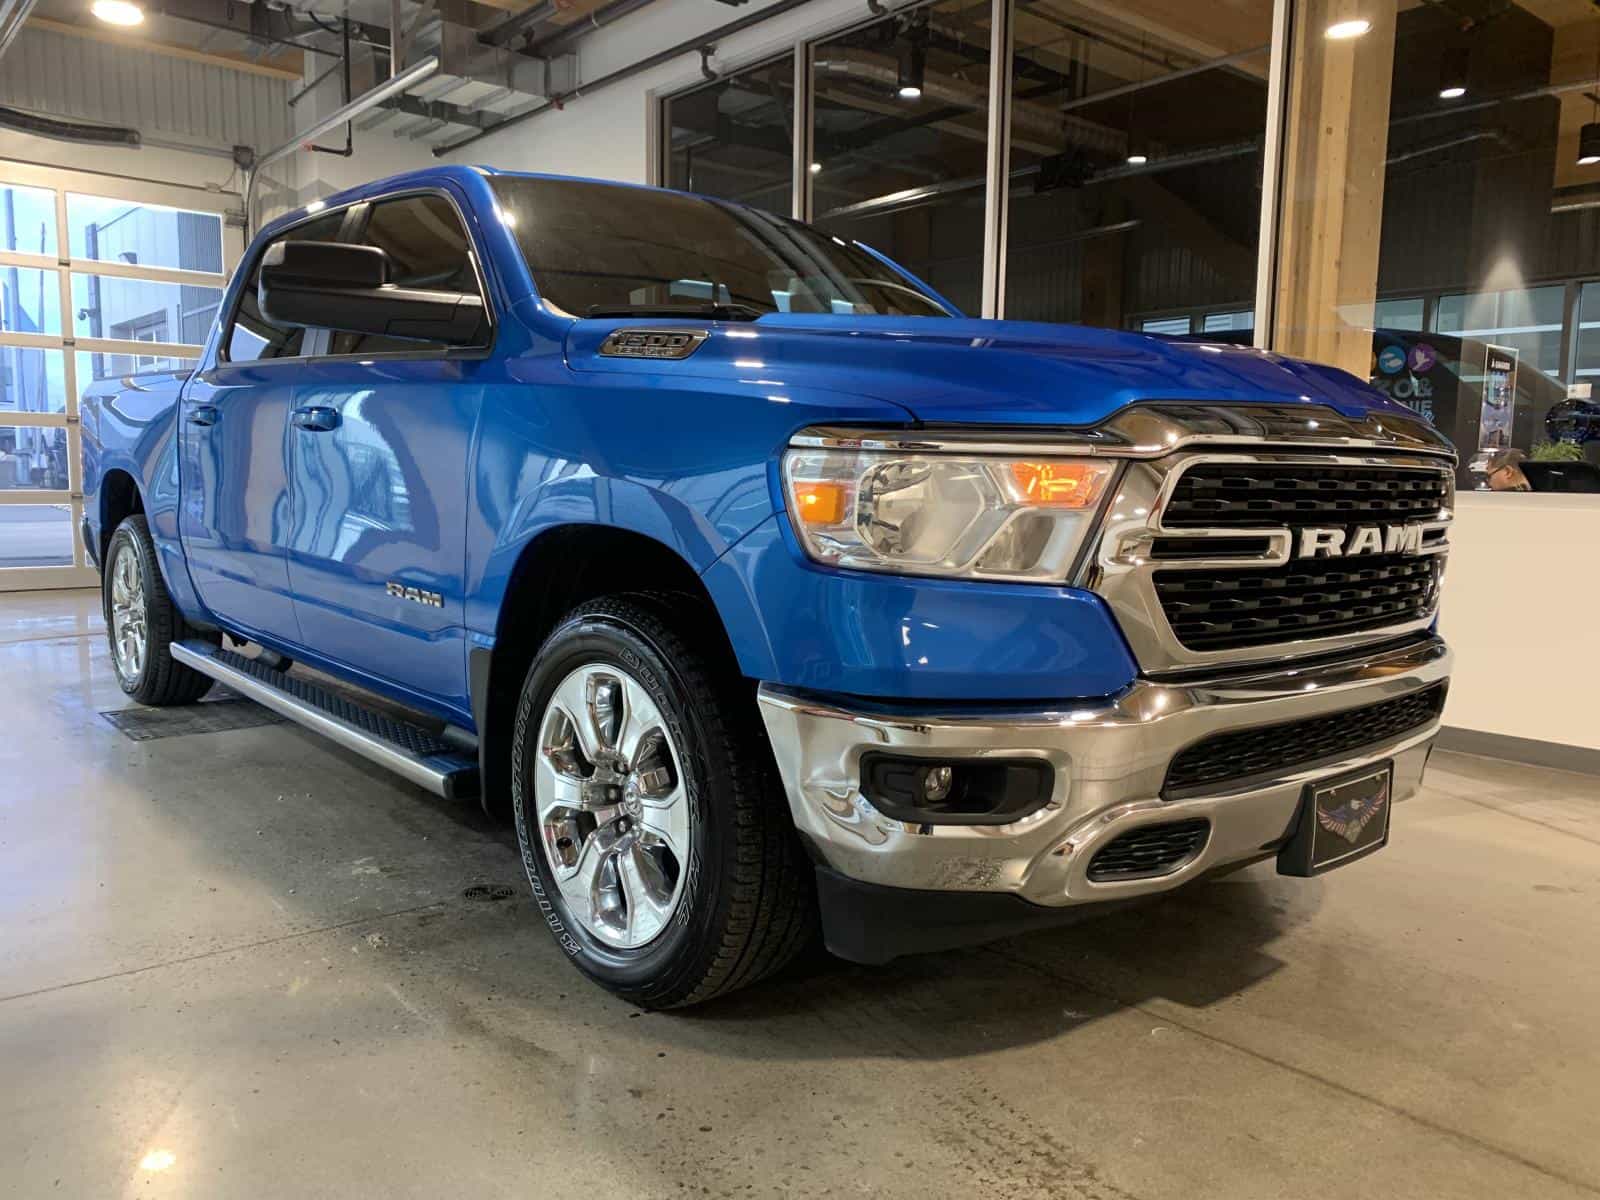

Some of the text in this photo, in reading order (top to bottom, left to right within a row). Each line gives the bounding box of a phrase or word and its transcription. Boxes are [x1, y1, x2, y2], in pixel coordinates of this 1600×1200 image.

[613, 333, 691, 346] 1500
[1299, 524, 1419, 558] RAM
[386, 582, 441, 608] RAM
[512, 694, 582, 956] BRIDGESTONE
